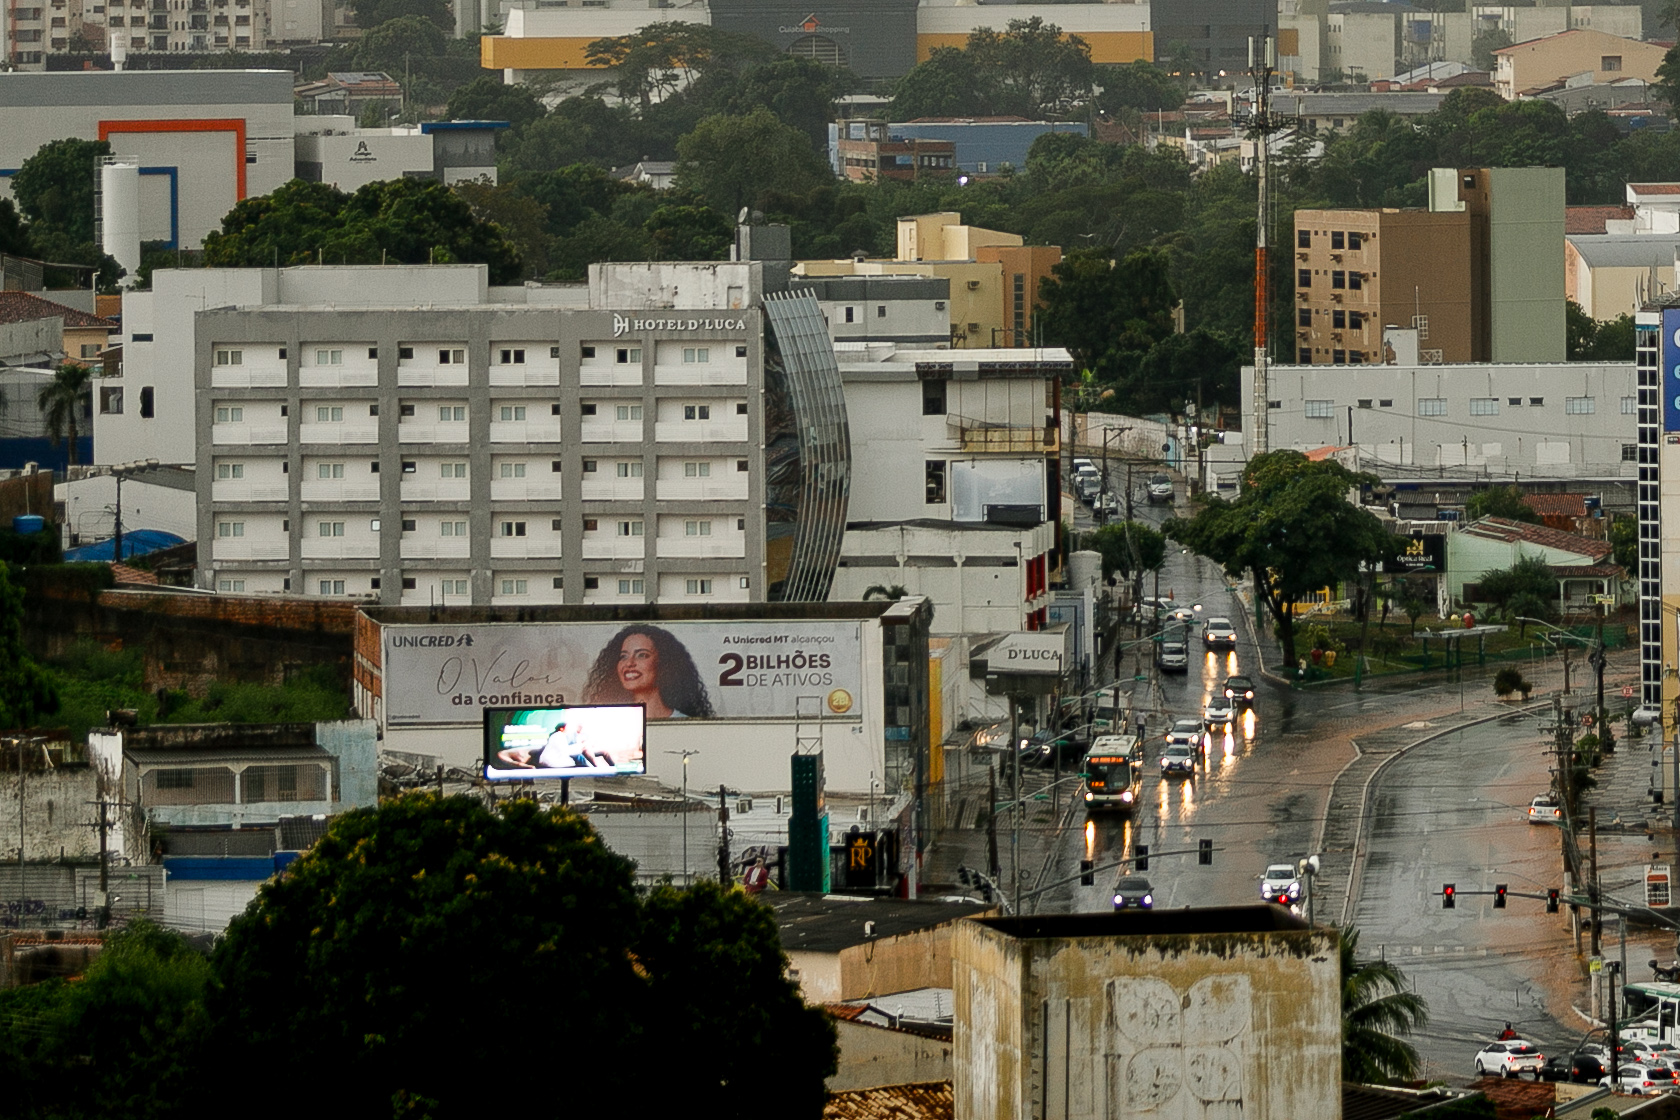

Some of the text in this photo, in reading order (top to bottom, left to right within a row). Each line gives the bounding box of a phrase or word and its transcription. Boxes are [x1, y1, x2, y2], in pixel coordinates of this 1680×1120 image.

[634, 319, 686, 330] HOTEL
[392, 636, 455, 648] UNICRED
[723, 635, 835, 645] A Unicred MT alcançou
[471, 649, 562, 694] Valor
[718, 650, 831, 687] 2 BILHÕES
[746, 673, 833, 687] DE ATIVOS
[451, 692, 565, 707] da confiança
[850, 847, 872, 867] RP
